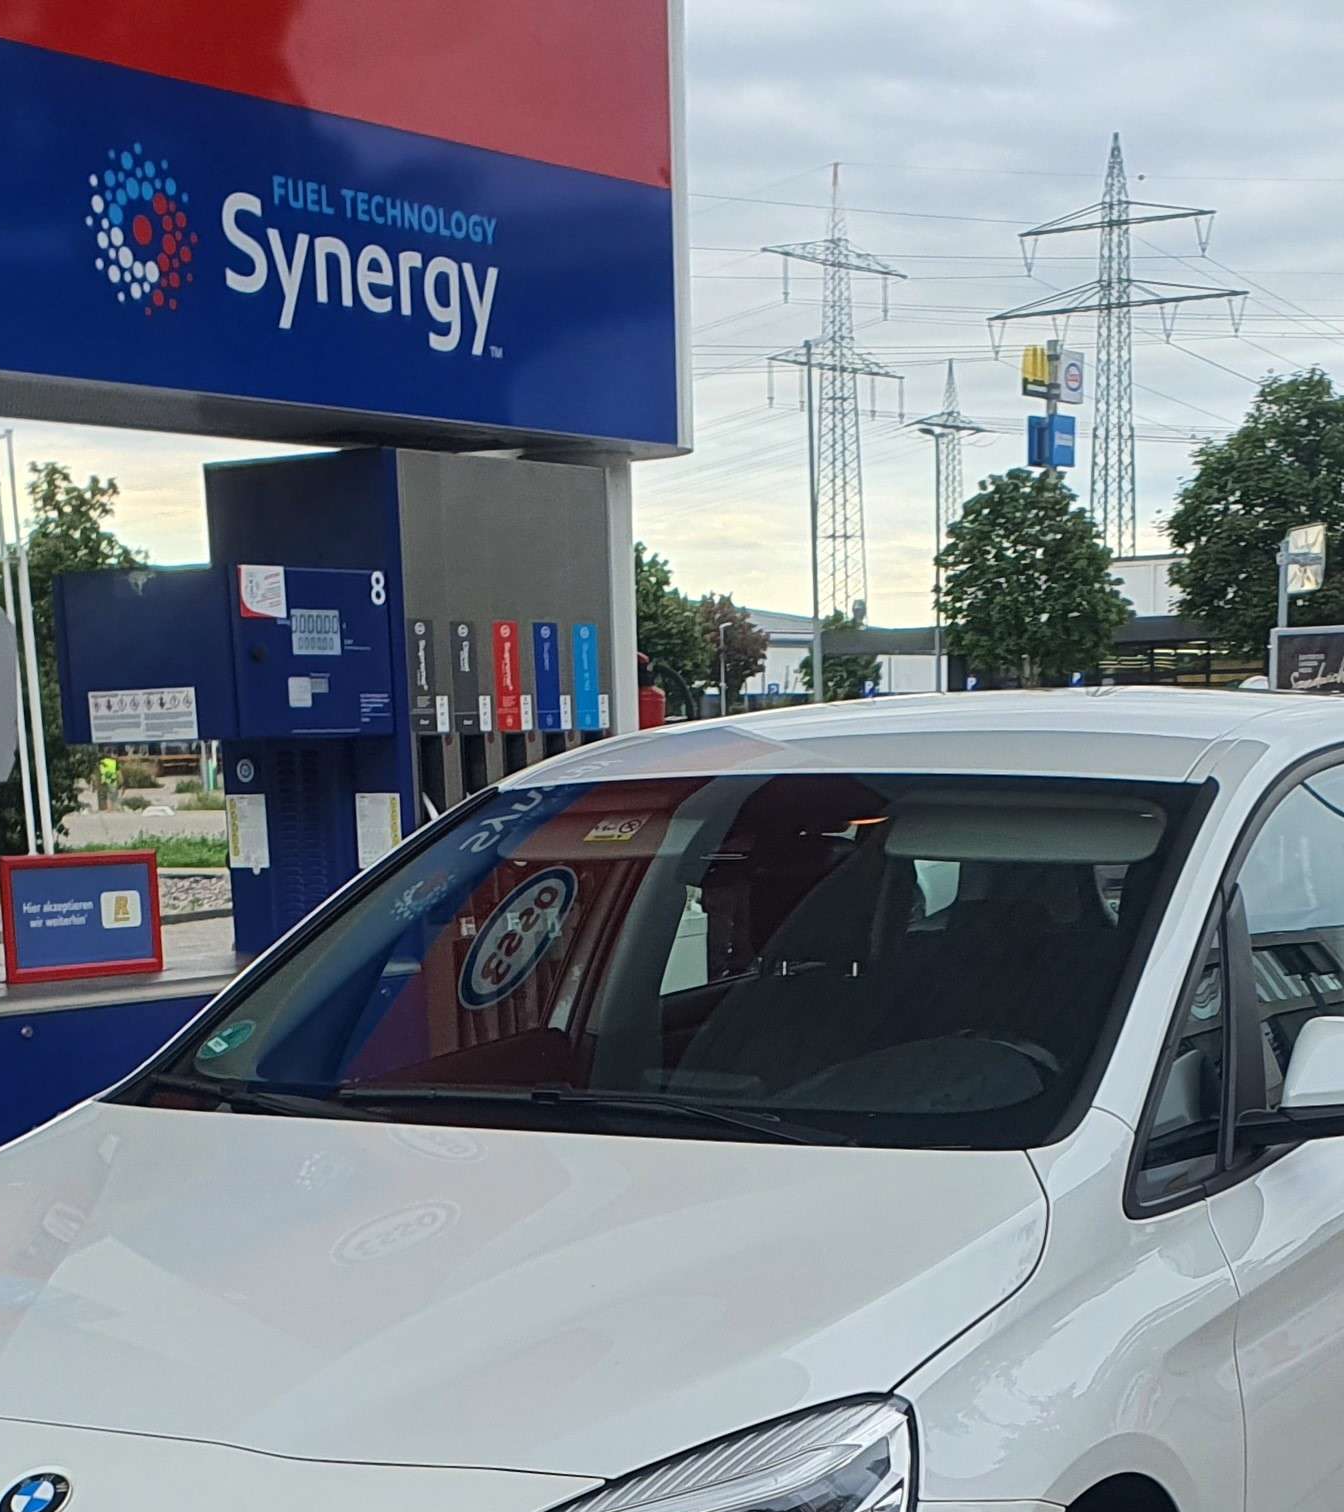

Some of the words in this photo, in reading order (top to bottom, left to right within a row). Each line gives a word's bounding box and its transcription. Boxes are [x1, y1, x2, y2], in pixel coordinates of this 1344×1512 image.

[272, 174, 334, 216] FUEL
[340, 188, 497, 245] TECHNOLOGY
[221, 191, 499, 359] Synergy
[370, 570, 387, 606] 8
